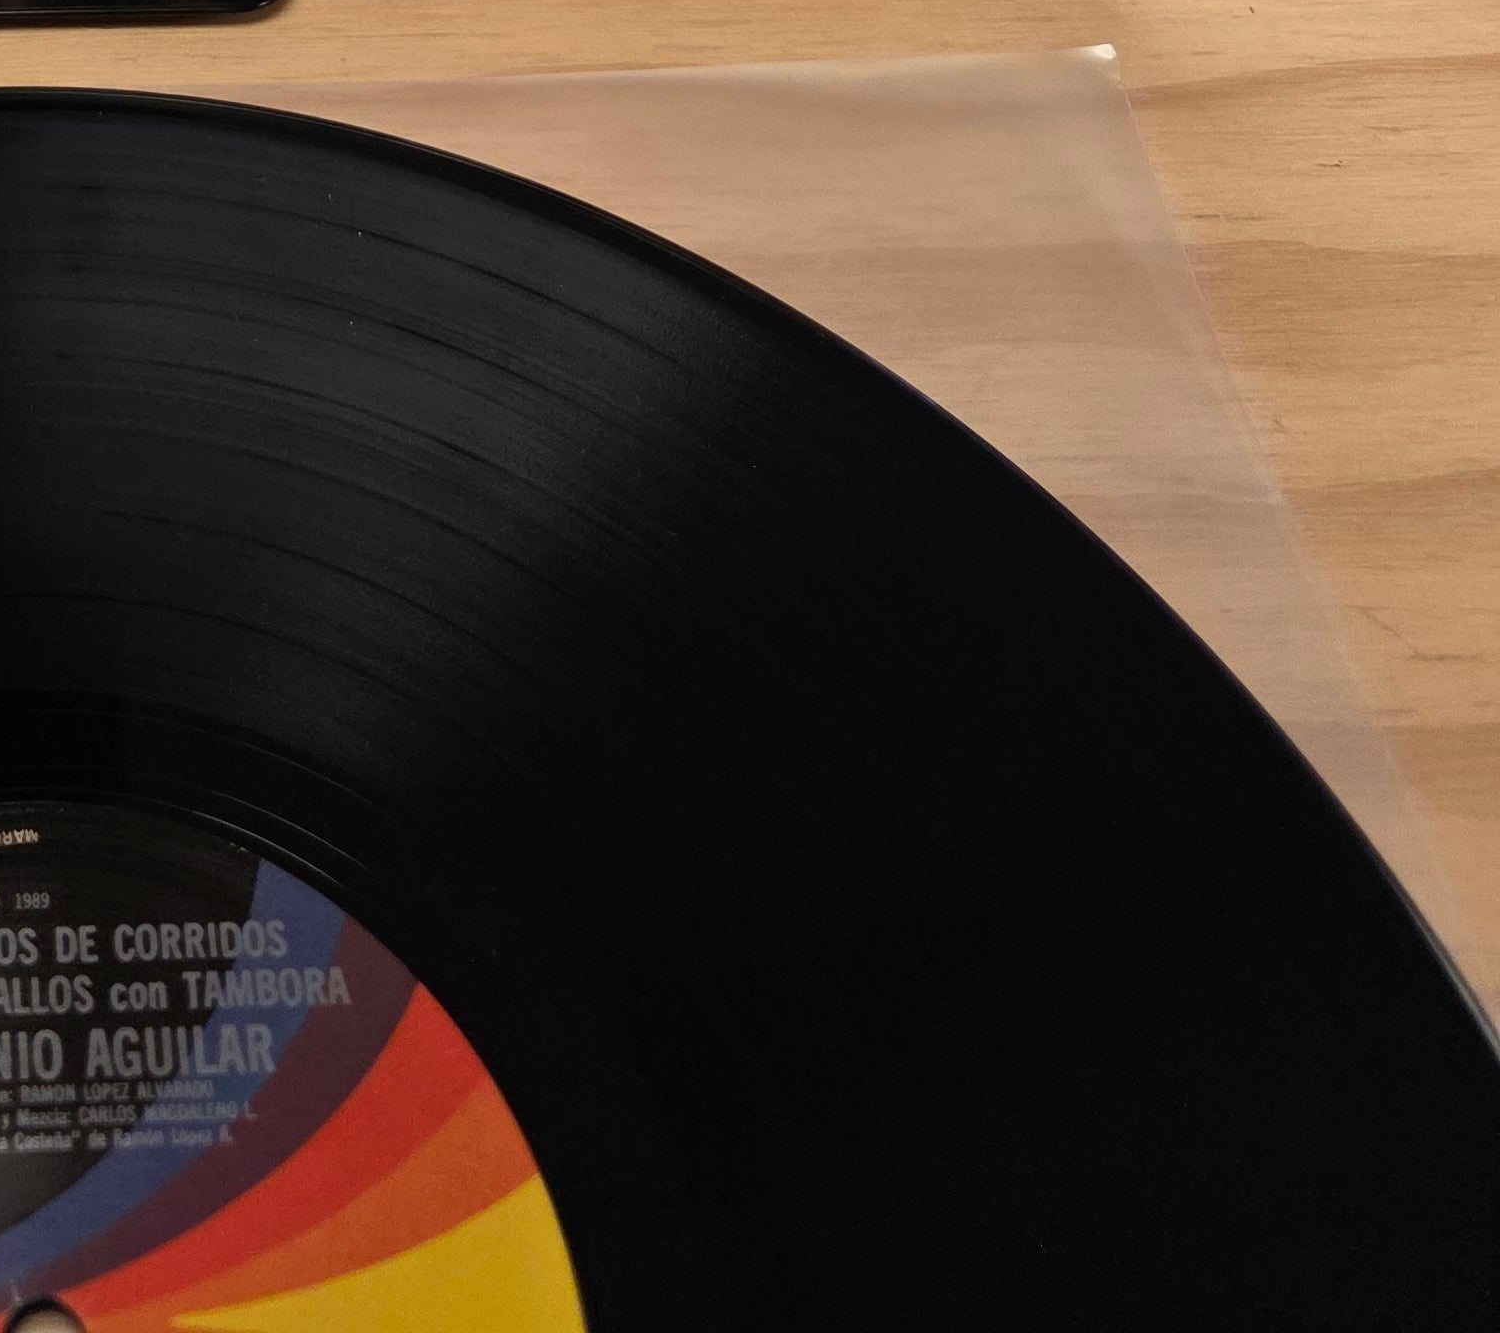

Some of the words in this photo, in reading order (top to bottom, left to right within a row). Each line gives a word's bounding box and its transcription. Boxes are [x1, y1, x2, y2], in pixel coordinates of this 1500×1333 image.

[14, 891, 51, 912] 1989
[55, 924, 100, 964] DE
[113, 918, 288, 962] CORRIDOS
[109, 980, 168, 1012] con
[181, 965, 352, 1010] TAMBORA
[85, 1022, 278, 1079] AGUILAR
[78, 1104, 137, 1126] CARLOS
